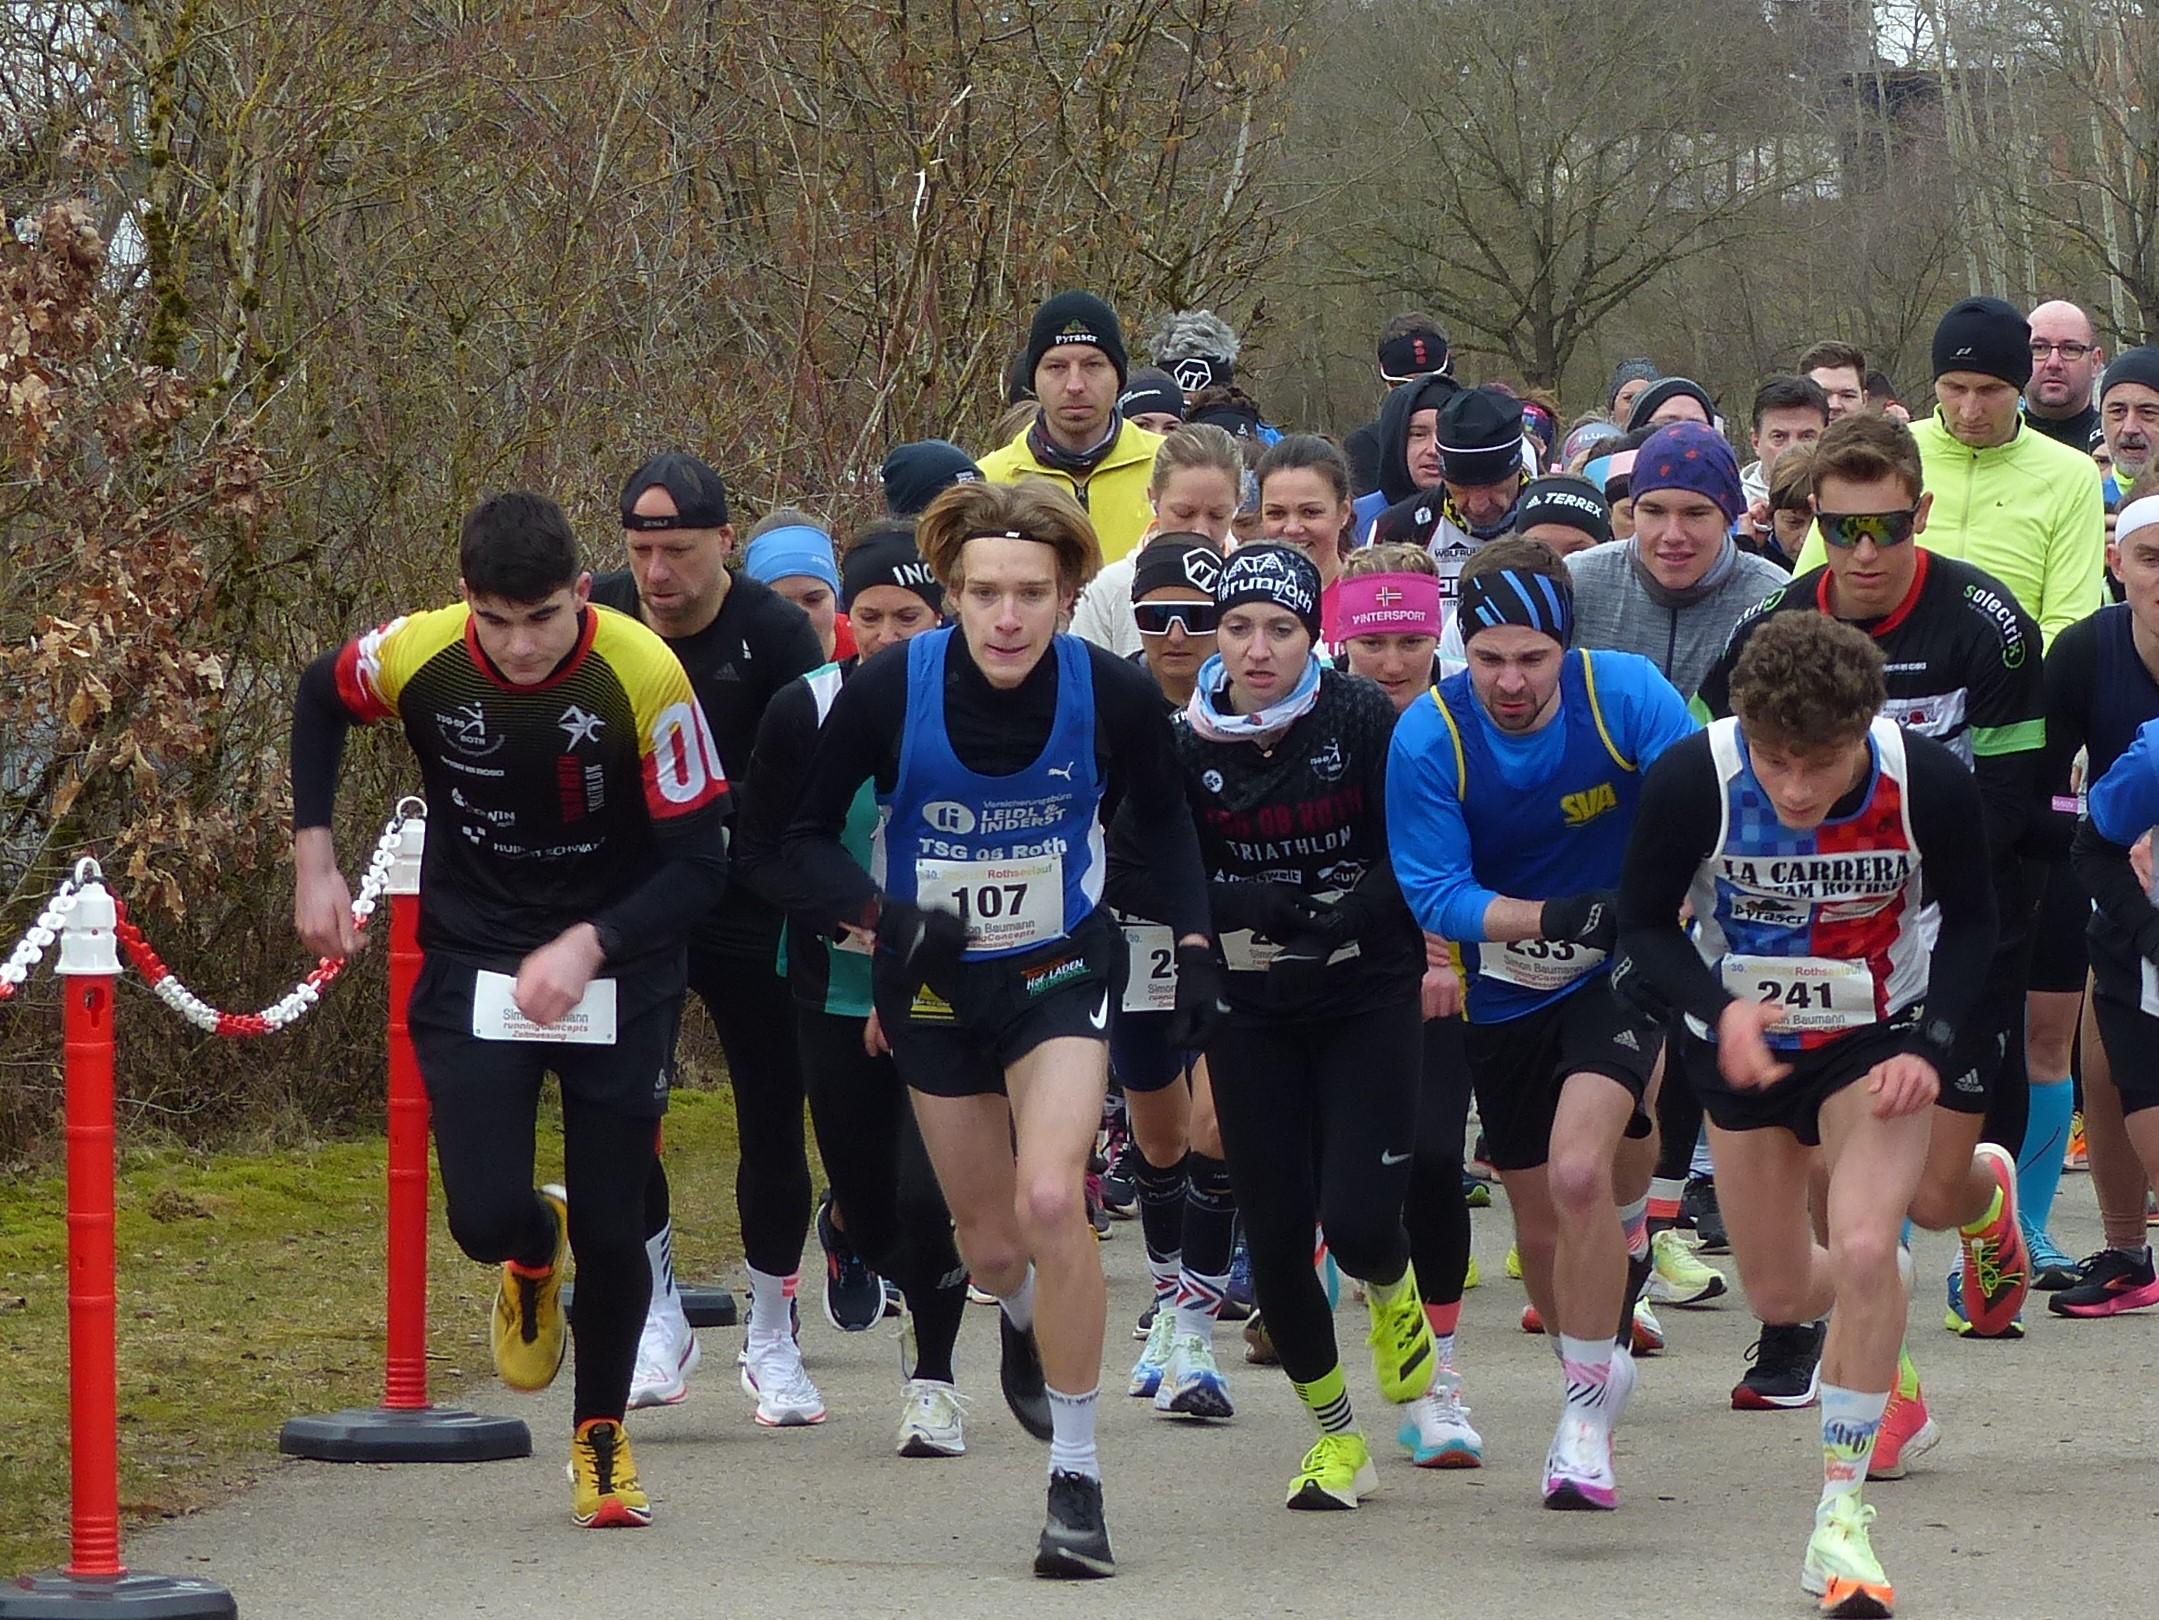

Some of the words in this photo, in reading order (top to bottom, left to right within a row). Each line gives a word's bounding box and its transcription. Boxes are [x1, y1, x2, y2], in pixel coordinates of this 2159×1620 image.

[1544, 492, 1602, 519] TERREX
[1963, 585, 2021, 658] solectrix
[980, 808, 1066, 835] INDERST
[981, 807, 1037, 822] LEIDL
[919, 838, 968, 860] TSG
[1012, 837, 1067, 860] Roth
[1226, 825, 1351, 862] TRIATHLON
[1723, 859, 1759, 885] LA
[1770, 854, 1911, 884] CARRERA
[951, 883, 1028, 918] 107
[985, 919, 1036, 934] Baumann
[1049, 957, 1084, 979] LADEN
[1758, 980, 1832, 1009] 241
[1793, 1014, 1845, 1025] Baumann
